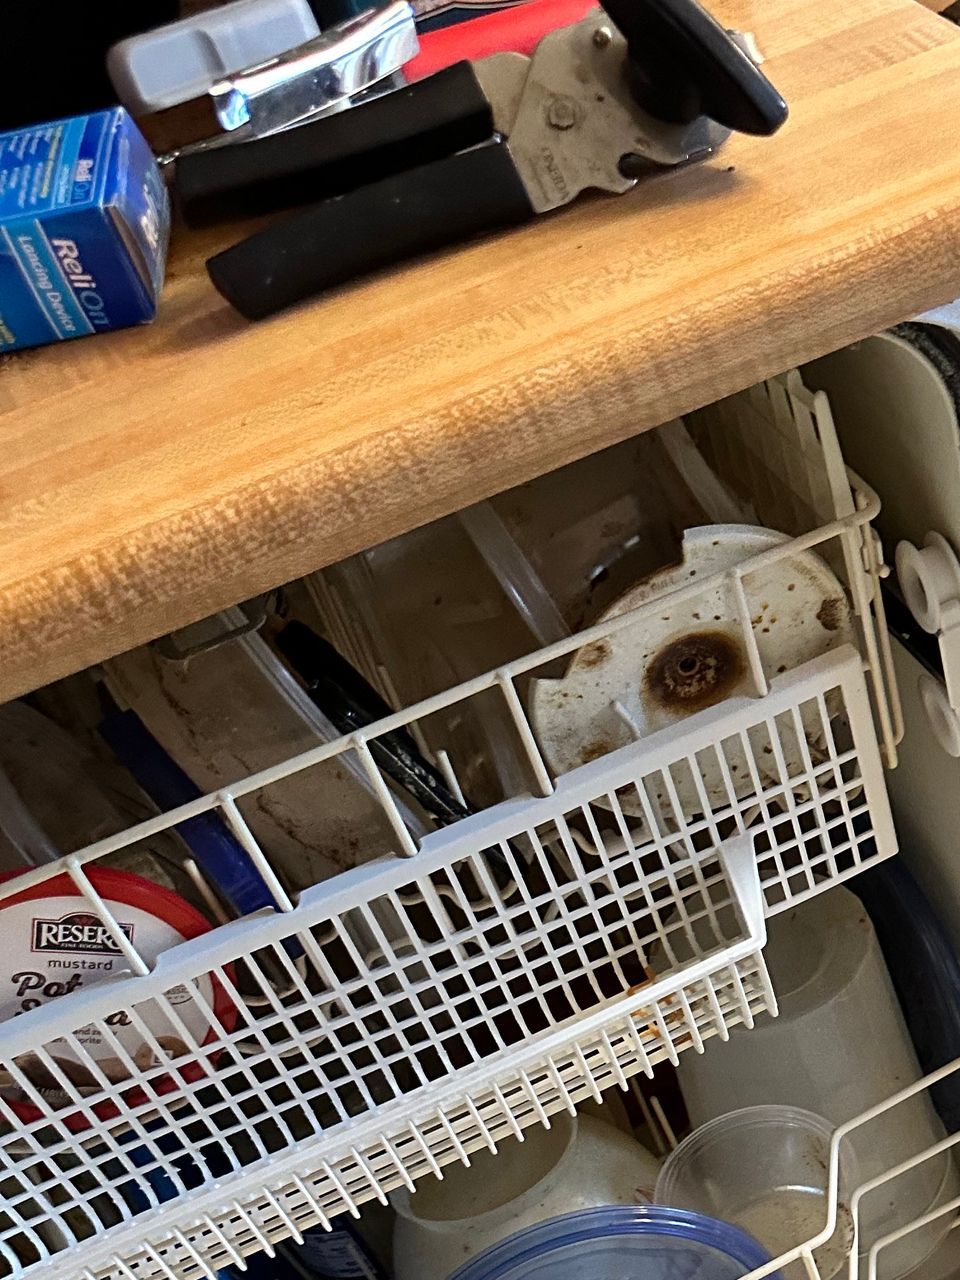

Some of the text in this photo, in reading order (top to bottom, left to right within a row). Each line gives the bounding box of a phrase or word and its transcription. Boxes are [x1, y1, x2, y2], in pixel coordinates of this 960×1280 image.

[17, 235, 53, 289] Lancing
[47, 291, 76, 332] Device
[47, 958, 113, 970] mustard
